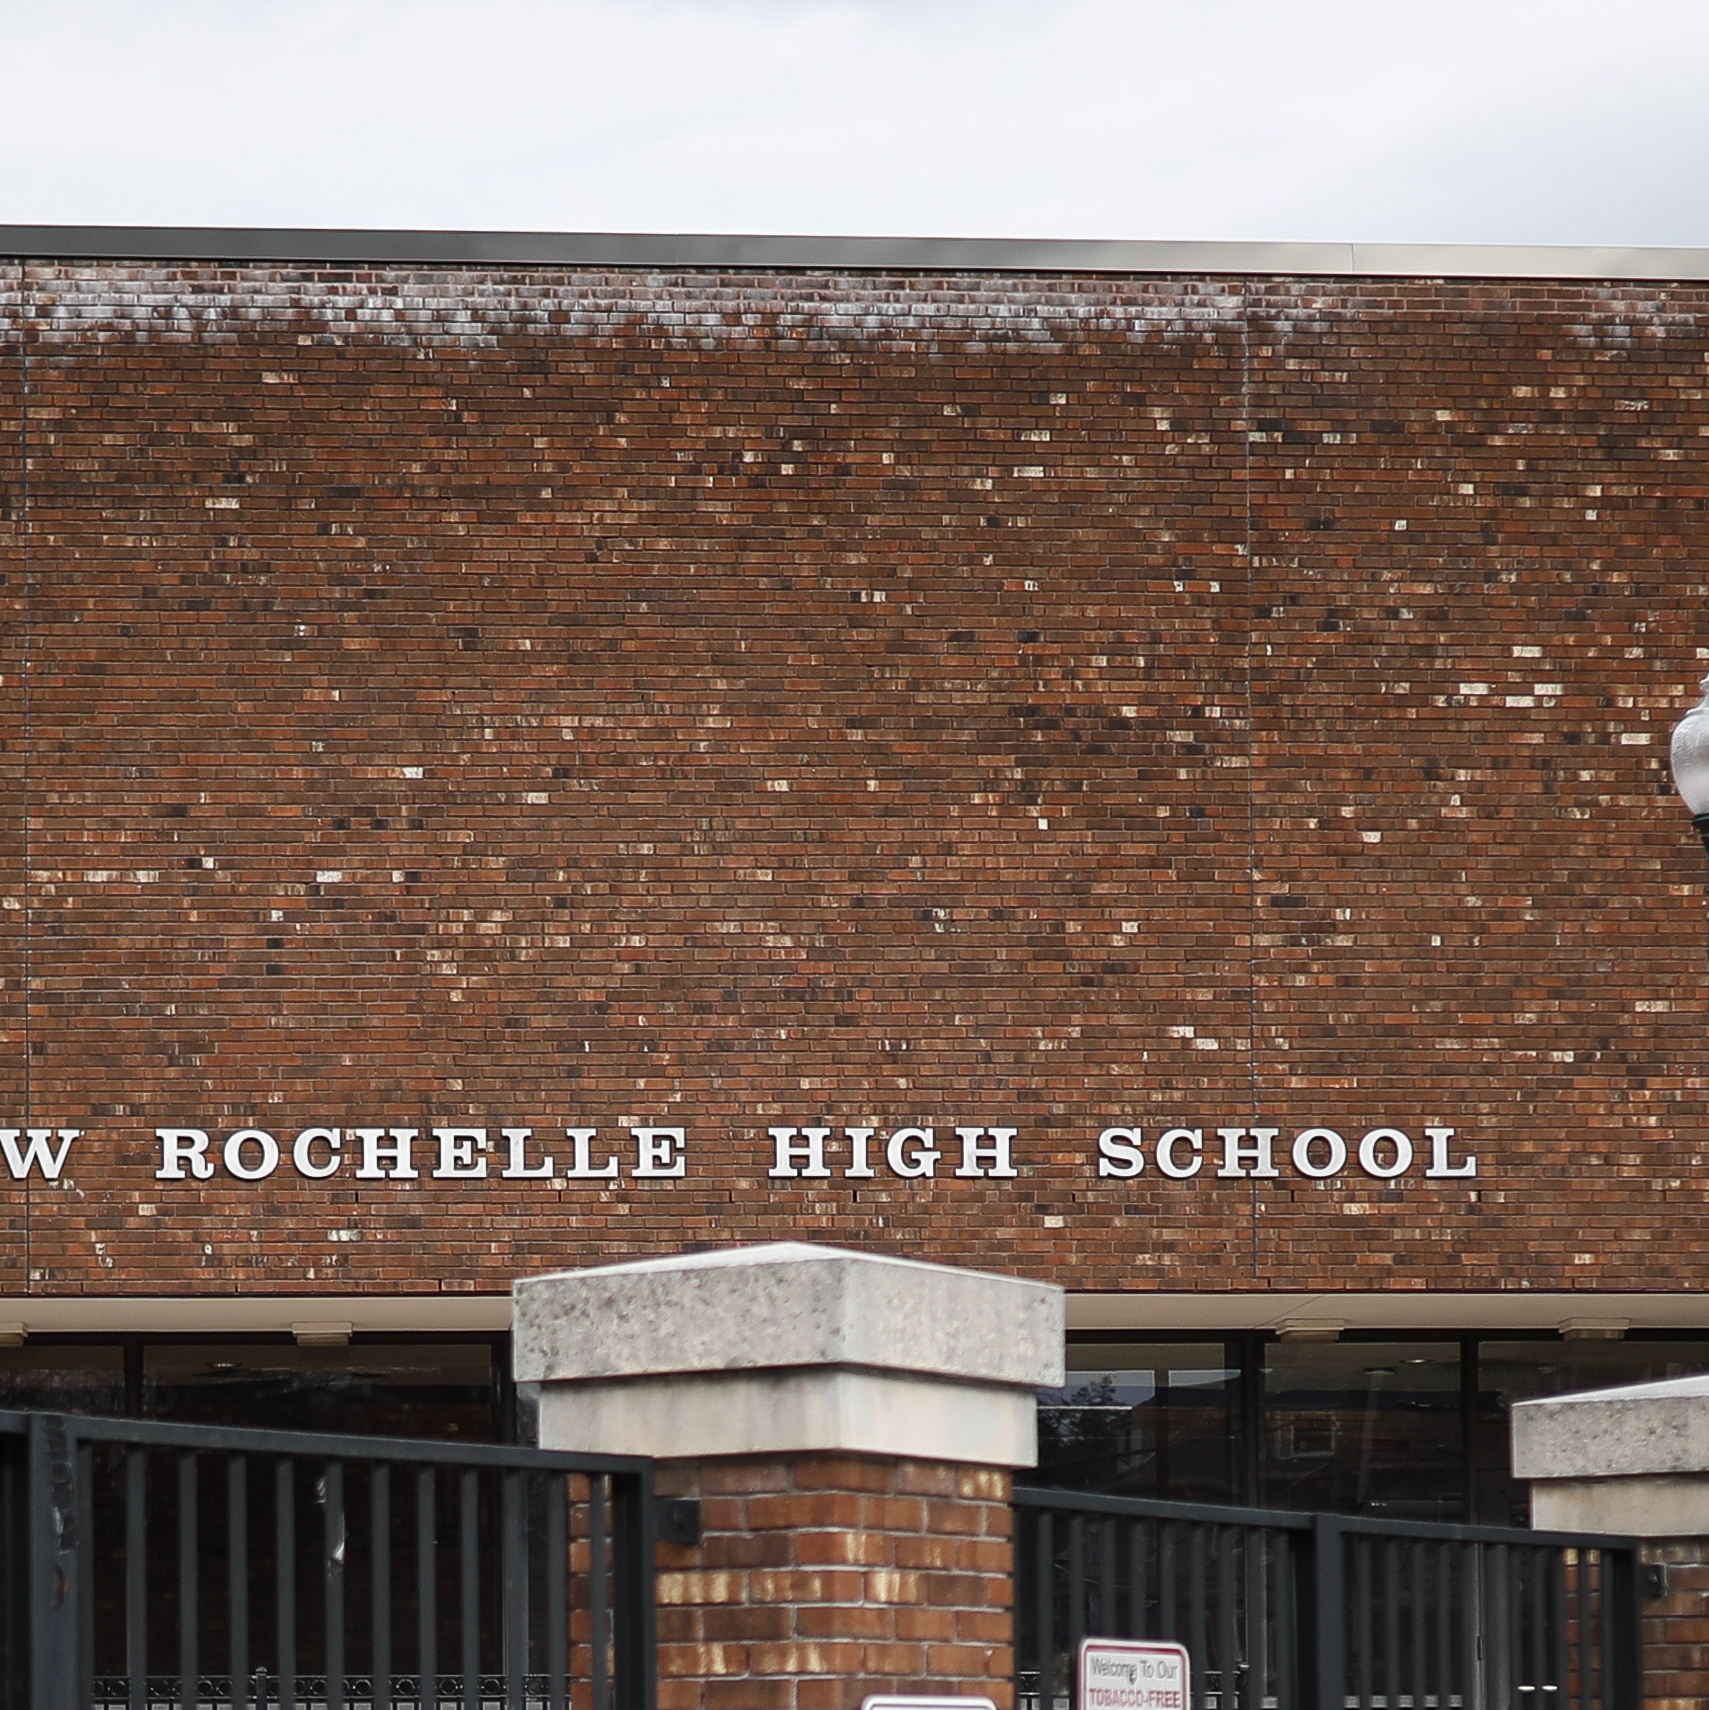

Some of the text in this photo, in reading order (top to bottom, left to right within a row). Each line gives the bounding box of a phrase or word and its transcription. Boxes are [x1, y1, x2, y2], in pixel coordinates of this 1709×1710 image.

[154, 1127, 688, 1181] ROCHELLE
[767, 1126, 1019, 1179] HIGH
[1097, 1127, 1478, 1179] SCHOOL
[1091, 1656, 1178, 1679] Welcome To Our
[1089, 1688, 1181, 1709] TOBACCO-FREE
